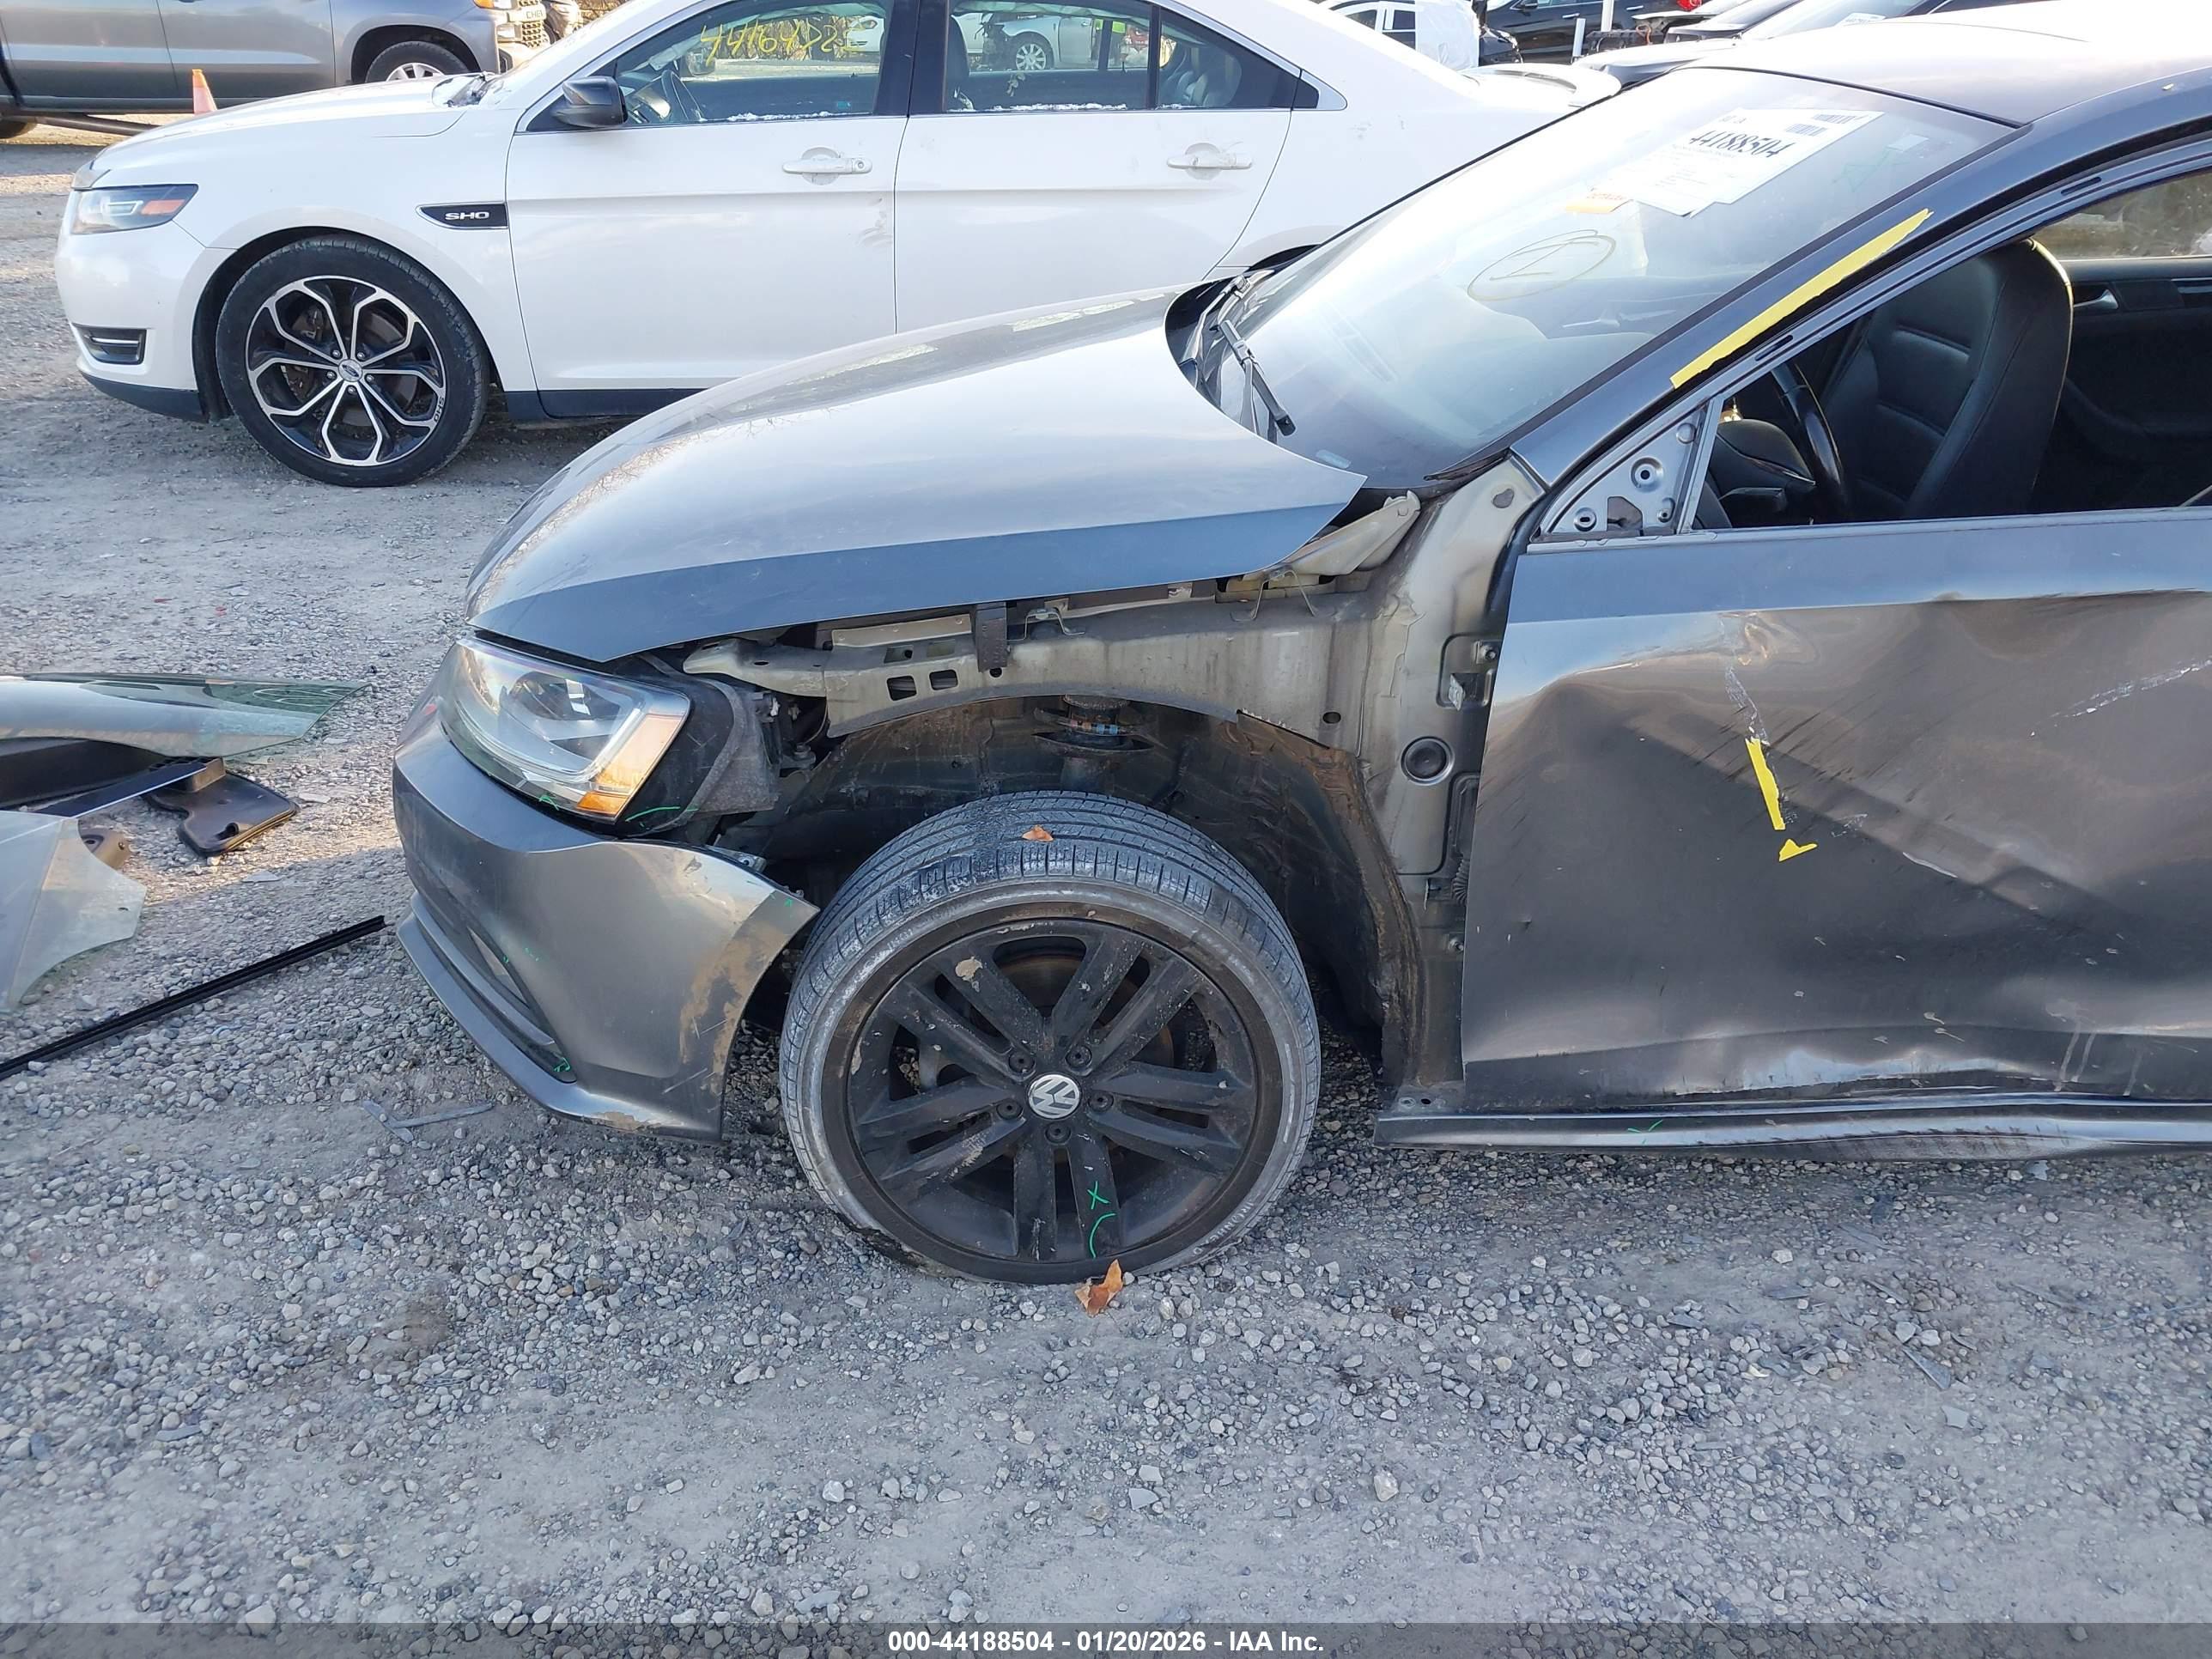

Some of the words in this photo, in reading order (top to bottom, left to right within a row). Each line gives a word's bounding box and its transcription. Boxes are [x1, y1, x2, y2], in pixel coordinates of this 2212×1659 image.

[1689, 130, 1796, 157] 44188504
[445, 211, 489, 220] SHO
[434, 396, 445, 422] SHO
